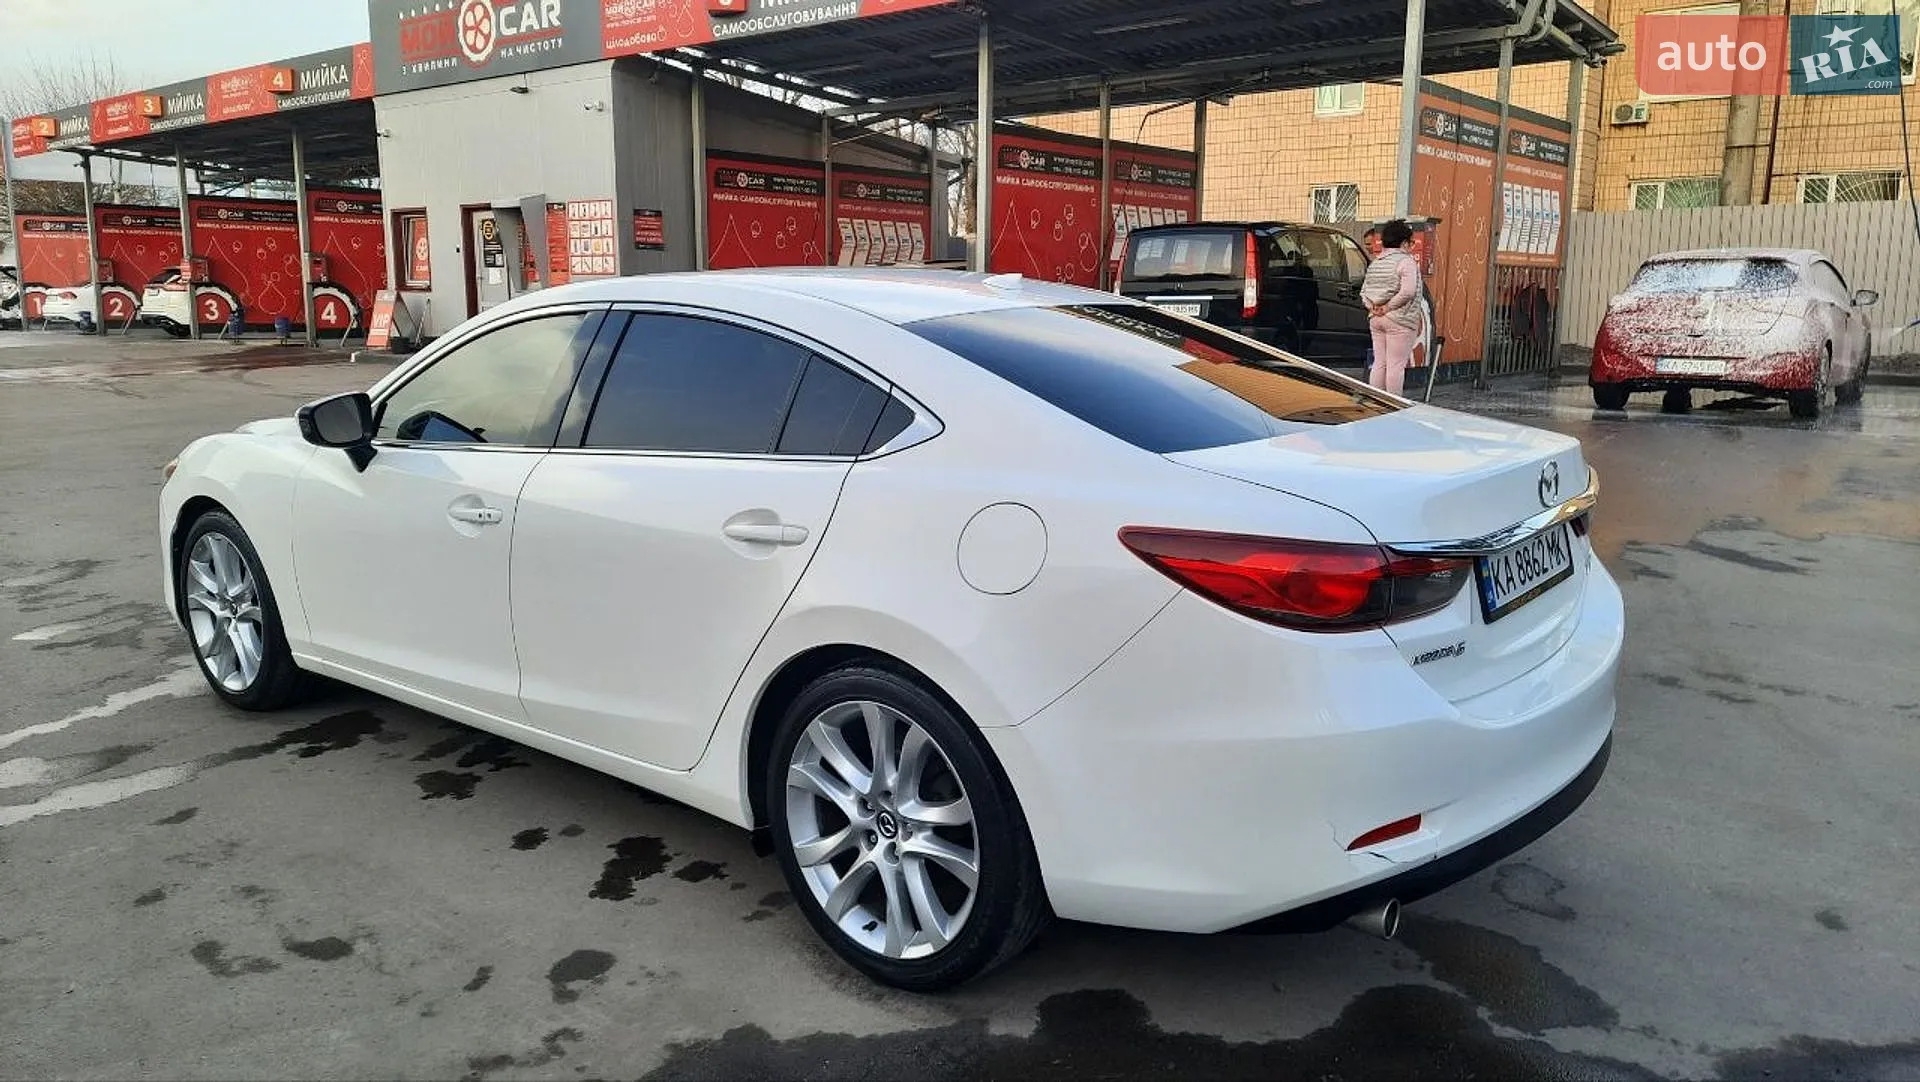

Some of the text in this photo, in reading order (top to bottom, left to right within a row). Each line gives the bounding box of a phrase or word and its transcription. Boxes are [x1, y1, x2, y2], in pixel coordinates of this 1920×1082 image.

[501, 0, 561, 36] CAR
[712, 2, 857, 37] САМООБСЛУГОВУВАННЯ
[516, 38, 563, 56] ЧИСТОТУ
[273, 71, 284, 88] 4
[301, 63, 349, 90] МИЙКА
[144, 99, 153, 113] 3
[39, 121, 48, 133] 2
[109, 297, 125, 317] 2
[205, 299, 218, 319] 3
[321, 302, 337, 324] 4
[373, 313, 391, 328] VIP
[1491, 554, 1516, 599] KA
[1516, 538, 1548, 586] 8862
